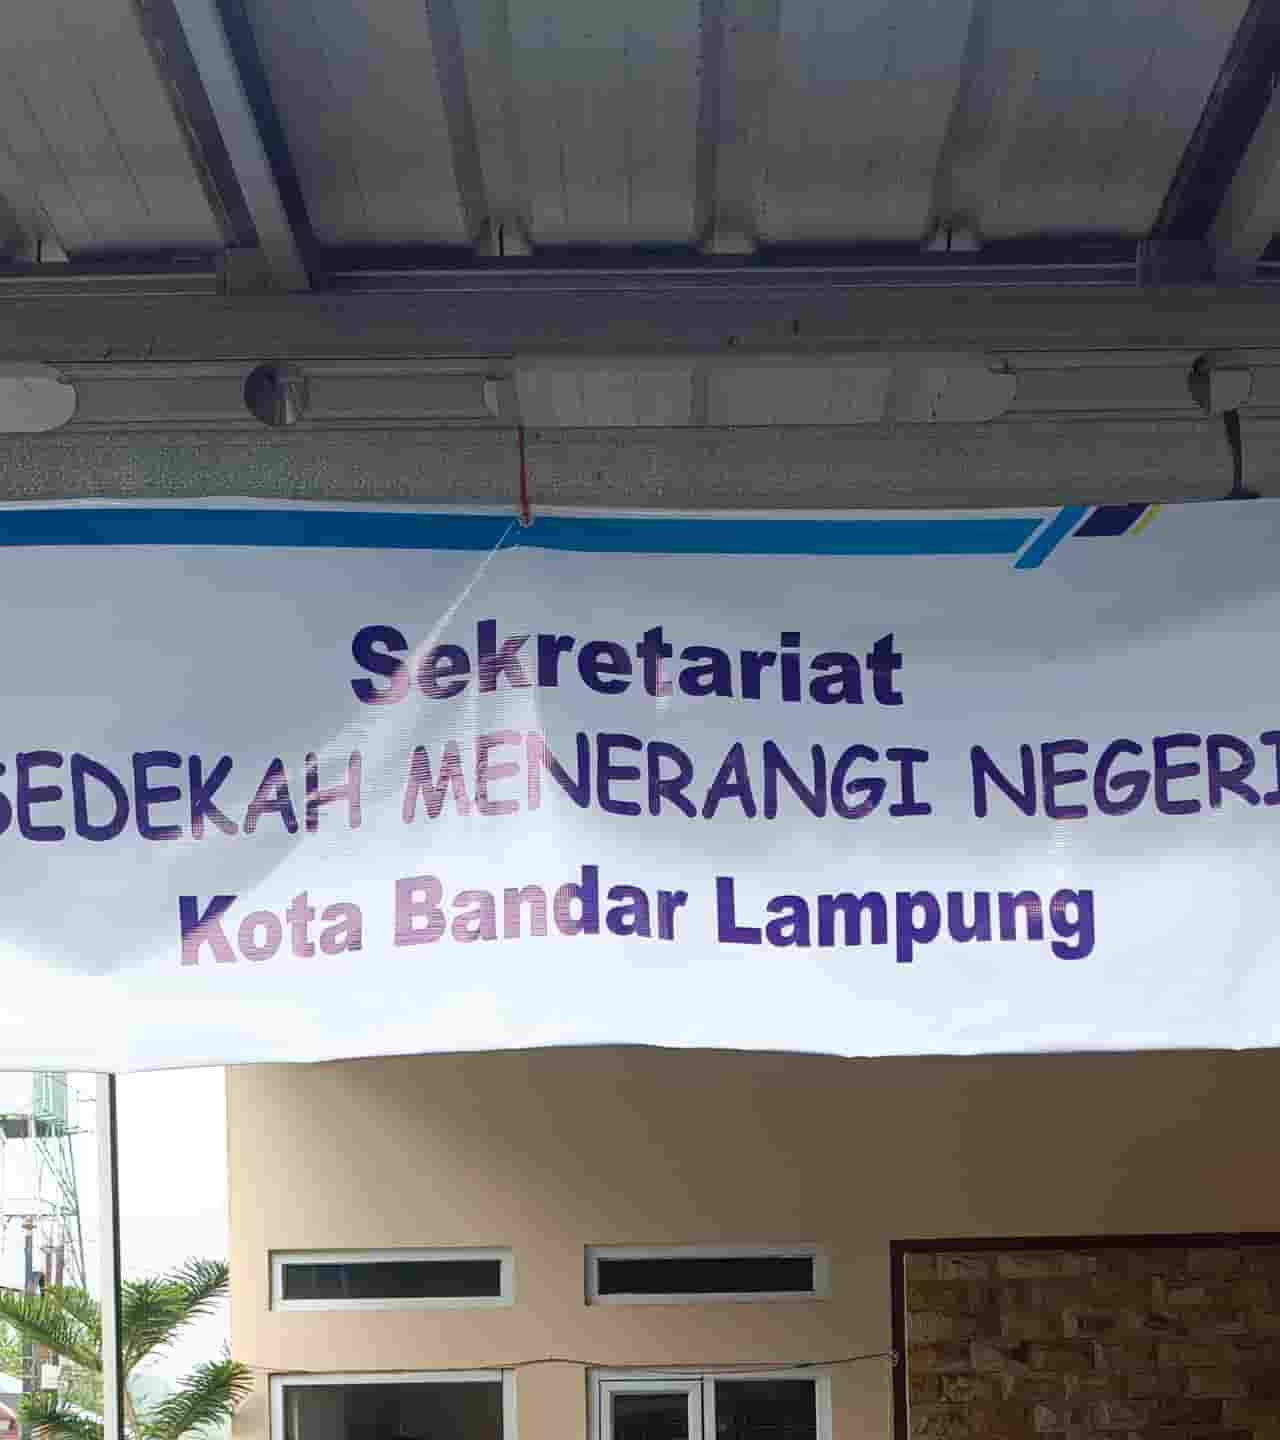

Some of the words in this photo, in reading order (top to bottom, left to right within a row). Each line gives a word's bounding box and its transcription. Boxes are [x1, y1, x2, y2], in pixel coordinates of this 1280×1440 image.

[351, 619, 904, 706] Sekretariat
[402, 730, 931, 824] MENERANGI
[179, 892, 363, 967] Kota
[395, 865, 688, 947] Bandar
[716, 875, 1096, 963] Lampung
